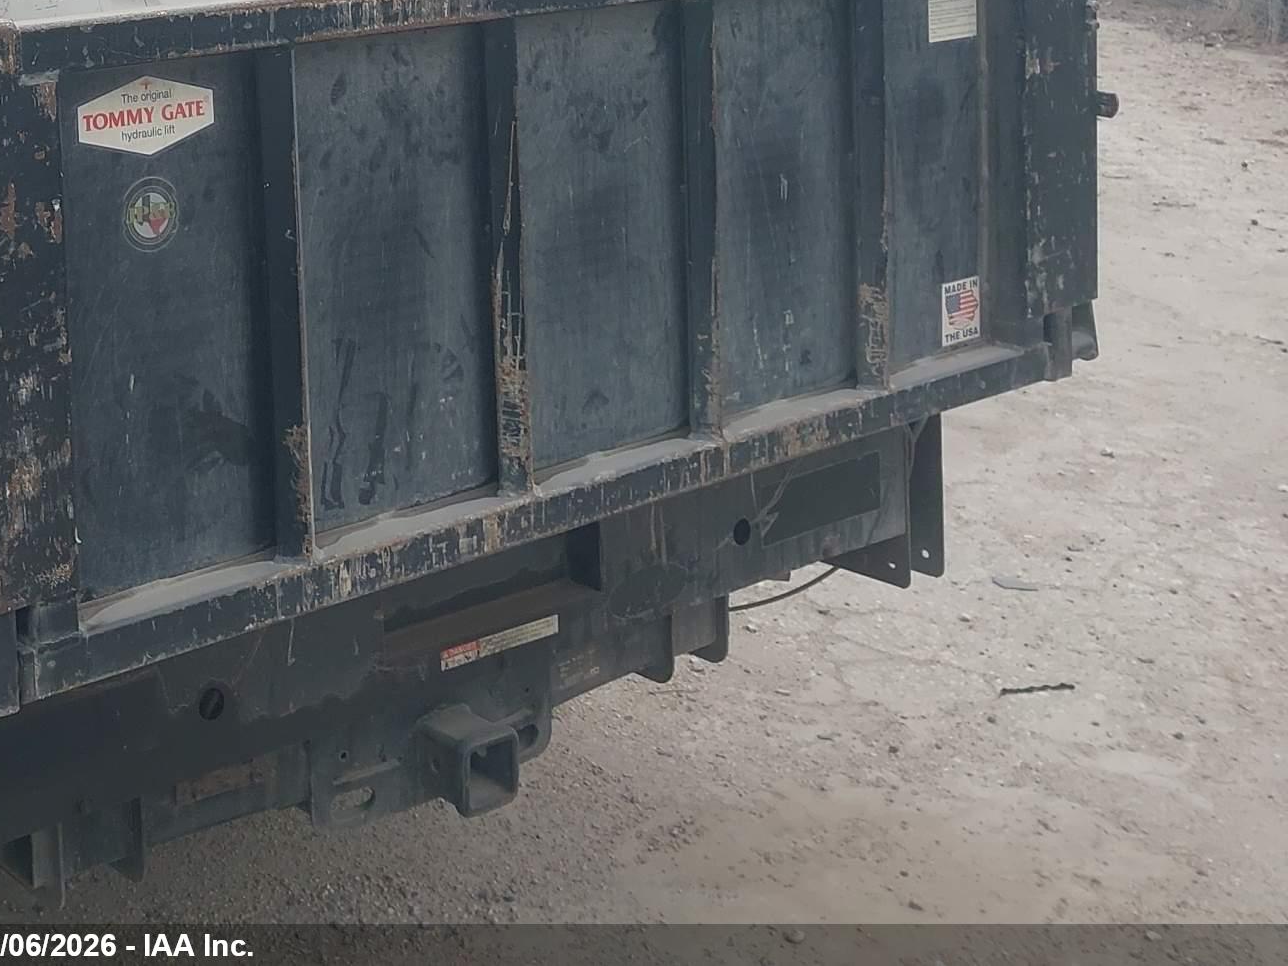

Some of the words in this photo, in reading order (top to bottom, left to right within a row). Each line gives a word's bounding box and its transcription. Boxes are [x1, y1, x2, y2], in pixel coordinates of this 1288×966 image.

[121, 94, 138, 104] The
[141, 89, 172, 103] original
[83, 107, 154, 131] TOMMY
[161, 100, 205, 121] GATE
[122, 127, 162, 142] hydraulic
[164, 125, 175, 138] lift
[944, 281, 967, 294] MADE
[969, 278, 978, 288] IN
[945, 331, 960, 343] THE
[963, 326, 978, 338] USA
